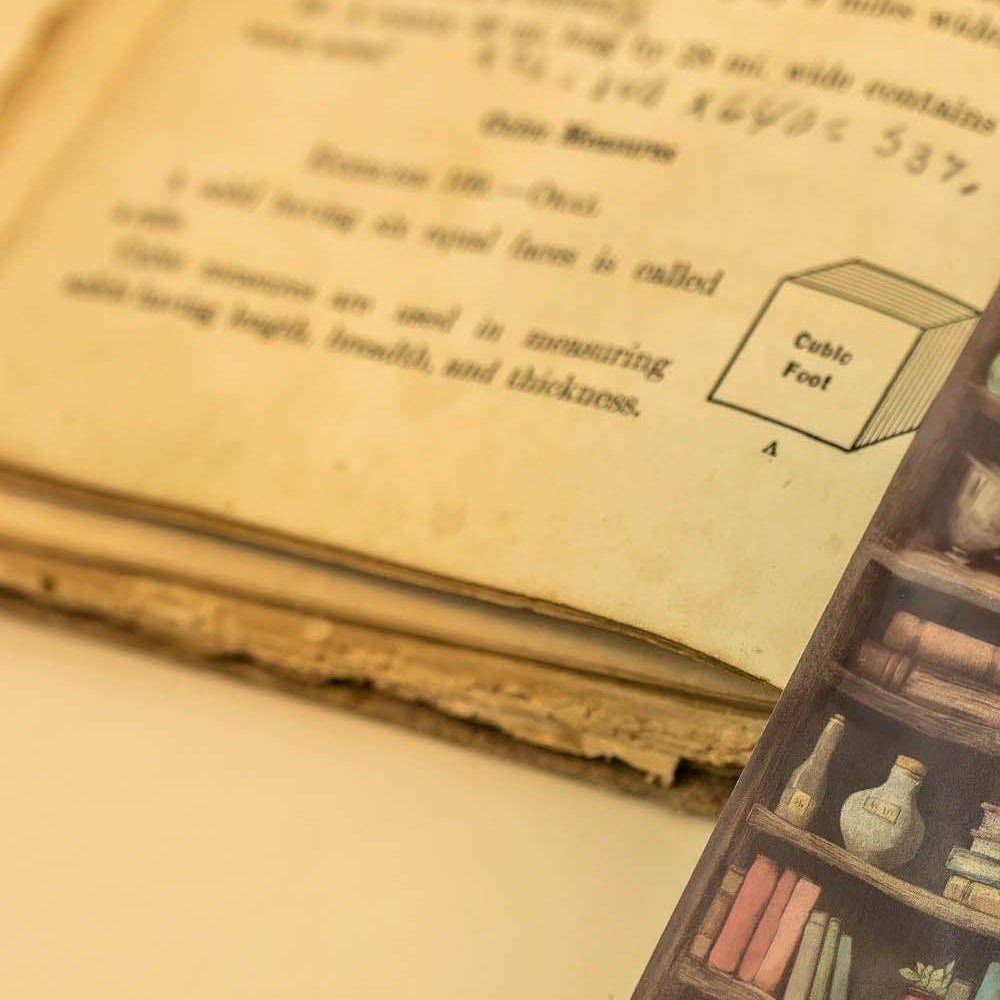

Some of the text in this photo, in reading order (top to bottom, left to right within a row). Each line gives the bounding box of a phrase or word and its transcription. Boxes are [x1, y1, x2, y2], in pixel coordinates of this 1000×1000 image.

[793, 330, 853, 367] Cubic
[506, 367, 640, 418] thickness.
[782, 360, 832, 392] Foot
